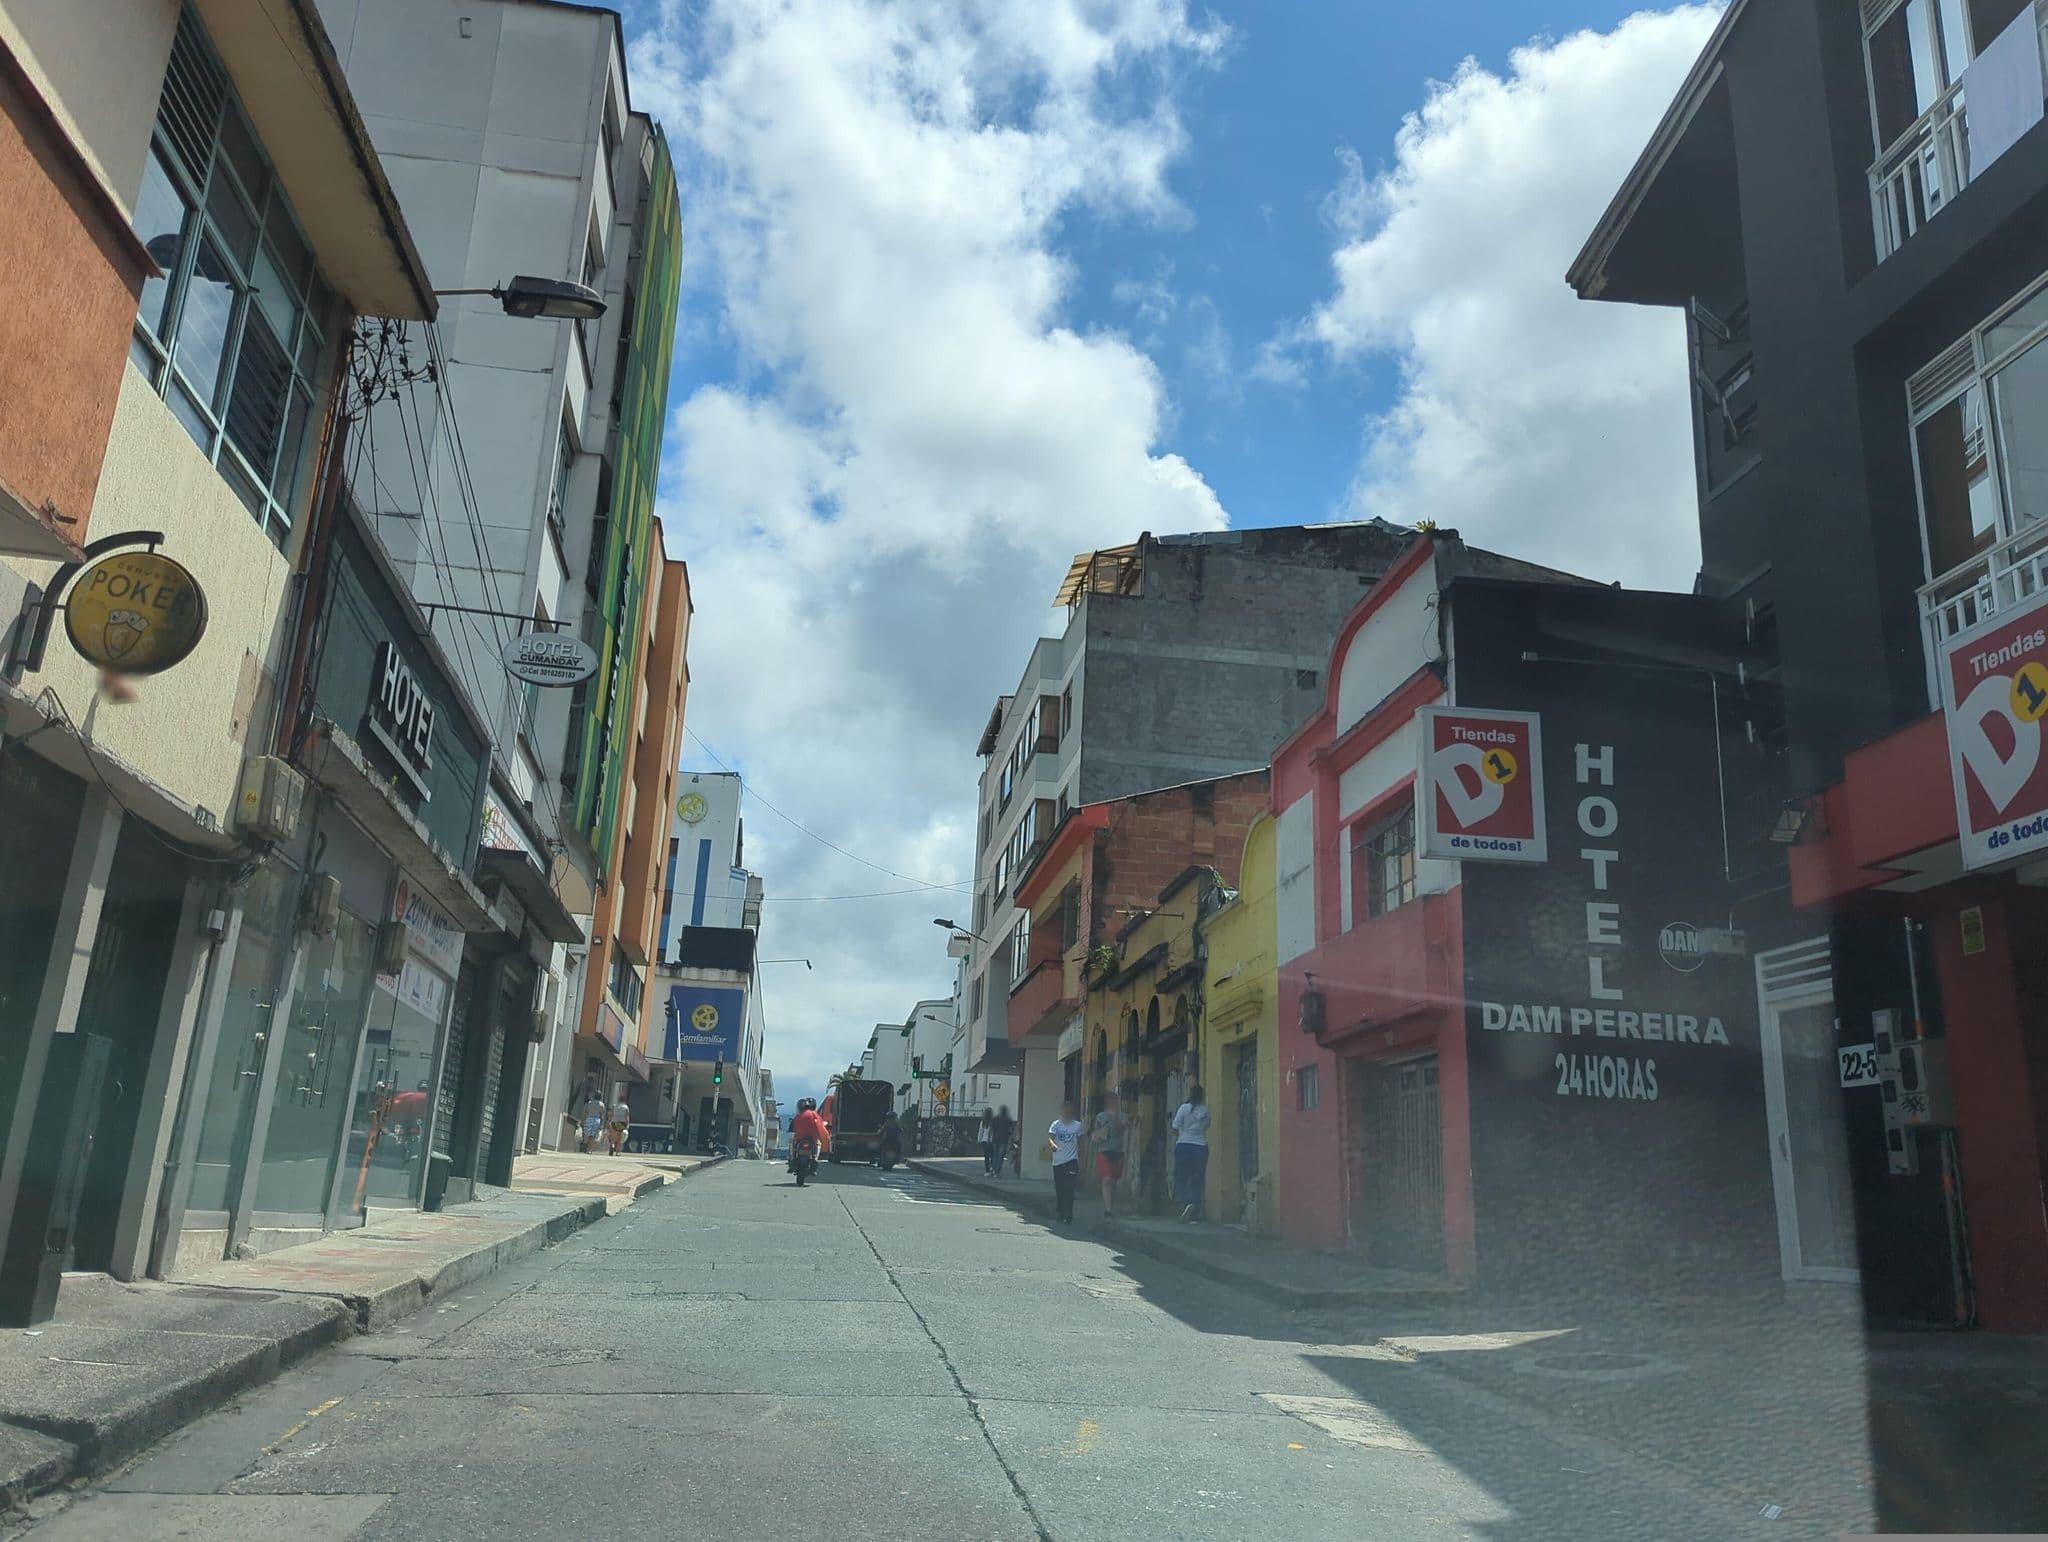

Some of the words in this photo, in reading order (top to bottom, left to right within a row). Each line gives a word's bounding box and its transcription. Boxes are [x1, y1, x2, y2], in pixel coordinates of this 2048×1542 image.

[519, 639, 583, 660] HOTEL
[520, 653, 580, 666] CUMANDAY
[1970, 629, 2046, 677] Tiendas
[381, 641, 435, 770] HOTEL
[1451, 726, 1516, 744] Tiendas
[1451, 837, 1470, 848] de
[1474, 837, 1522, 852] todos!
[1988, 830, 2010, 849] de
[1574, 743, 1623, 1001] HOTEL
[1482, 1002, 1563, 1034] DAM
[1570, 1007, 1730, 1046] PEREIRA
[680, 1032, 727, 1044] Comfamiliar
